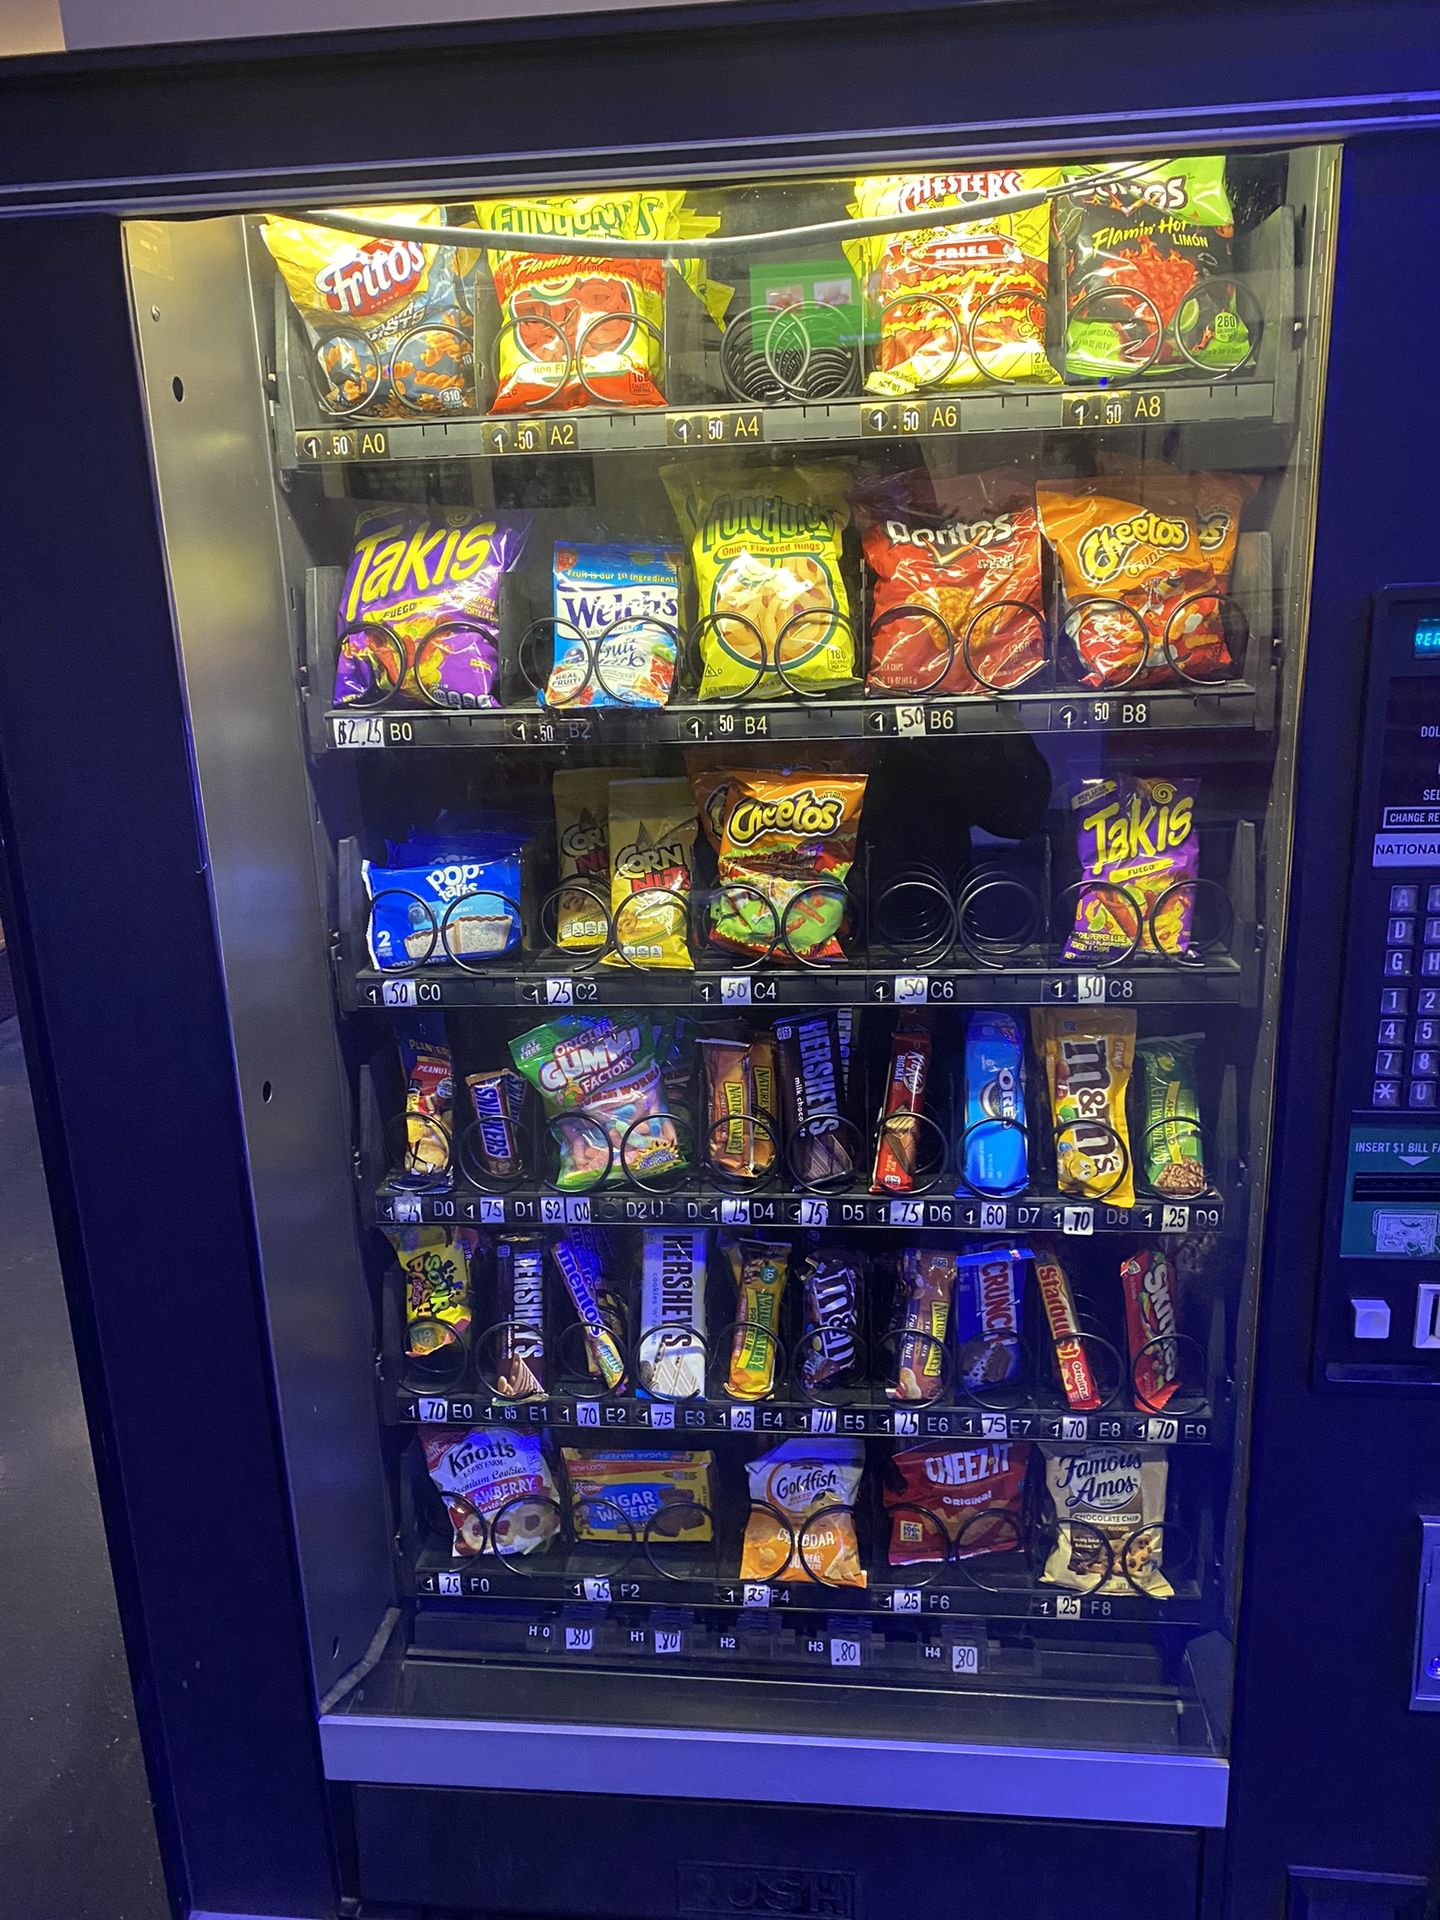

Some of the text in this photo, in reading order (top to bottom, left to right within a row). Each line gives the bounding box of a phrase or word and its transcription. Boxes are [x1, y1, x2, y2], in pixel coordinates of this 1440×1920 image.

[935, 245, 989, 260] FRIES
[315, 239, 425, 313] Fritos
[1217, 315, 1236, 328] 260
[443, 389, 460, 402] 310
[1134, 395, 1161, 418] A8
[931, 406, 958, 427] A6
[735, 415, 760, 437] A4
[362, 433, 386, 454] A0
[550, 424, 575, 446] A2
[750, 542, 791, 554] Flavored
[1081, 511, 1187, 582] Cheetos
[382, 603, 417, 620] FUEGO
[930, 710, 955, 730] B6
[1122, 703, 1148, 724] B8
[389, 722, 413, 742] B0
[745, 716, 768, 735] B4
[730, 789, 843, 842] Cheetos
[1389, 812, 1425, 824] CHANGE
[615, 843, 694, 880] CORN
[1128, 865, 1155, 877] FUEGO
[1397, 889, 1409, 905] A
[1395, 921, 1405, 938] D
[377, 930, 391, 948] 2
[1392, 952, 1403, 970] G
[419, 984, 442, 1001] C0
[575, 983, 598, 1000] C2
[754, 983, 777, 999] C4
[930, 981, 954, 998] C6
[1109, 980, 1133, 998] C8
[1391, 991, 1436, 1009] 1 2
[1385, 1022, 1432, 1040] 4 5
[1383, 1053, 1430, 1070] 7 8
[581, 1057, 636, 1093] FACTORY
[798, 1019, 840, 1136] HERSHEYS
[1416, 1083, 1427, 1100] 0
[1354, 1141, 1429, 1154] INSERT $1 BILL
[433, 1200, 454, 1217] D0
[515, 1201, 534, 1217] D1
[752, 1203, 774, 1219] D4
[842, 1204, 865, 1221] D5
[929, 1205, 952, 1222] D6
[1018, 1207, 1041, 1224] D7
[1106, 1208, 1129, 1225] D8
[1195, 1209, 1219, 1226] D9
[661, 1234, 695, 1347] HERSHEYS
[1037, 1262, 1081, 1359] Starbust
[452, 1403, 473, 1419] E0
[529, 1406, 548, 1421] E1
[606, 1408, 627, 1423] E2
[684, 1410, 706, 1425] E3
[762, 1412, 784, 1428] E4
[843, 1415, 866, 1431] E5
[927, 1417, 949, 1433] E6
[1009, 1419, 1032, 1435] E7
[1099, 1422, 1121, 1438] E8
[1184, 1424, 1208, 1440] E9
[449, 1438, 517, 1478] Knott's
[492, 1466, 528, 1480] Cookies
[1056, 1452, 1143, 1488] Famous
[777, 1469, 838, 1499] Goldfish
[1065, 1475, 1139, 1508] Amos
[1074, 1513, 1139, 1523] CHOCOLATE CHIP
[470, 1578, 490, 1592] F0
[620, 1584, 640, 1598] F2
[771, 1589, 791, 1604] F4
[929, 1594, 950, 1610] F6
[1090, 1601, 1112, 1616] F8
[630, 1631, 645, 1642] H1
[719, 1637, 736, 1649] H2
[808, 1641, 825, 1652] H3
[925, 1647, 941, 1658] H4
